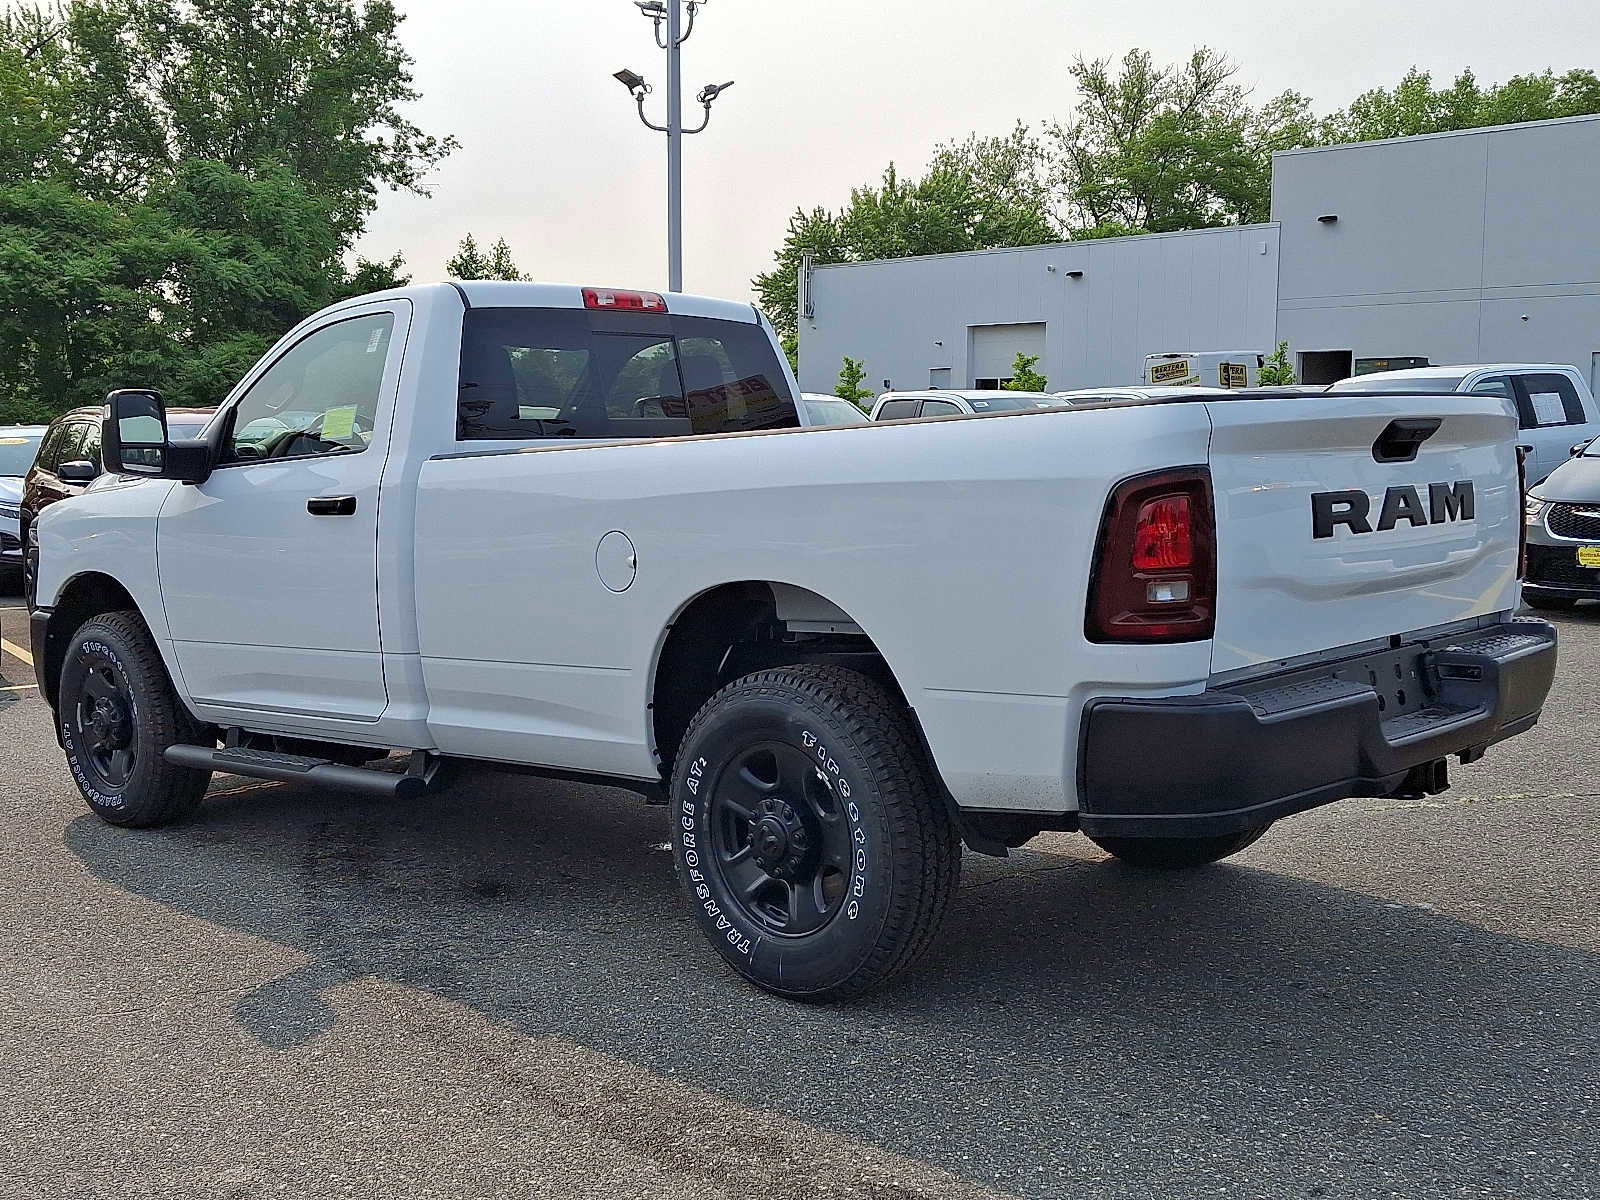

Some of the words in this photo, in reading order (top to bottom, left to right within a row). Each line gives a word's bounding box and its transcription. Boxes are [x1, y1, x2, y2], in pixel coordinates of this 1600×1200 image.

[1311, 480, 1475, 539] RAM
[682, 800, 751, 954] TRANSFORCE
[802, 730, 866, 919] Firestone
